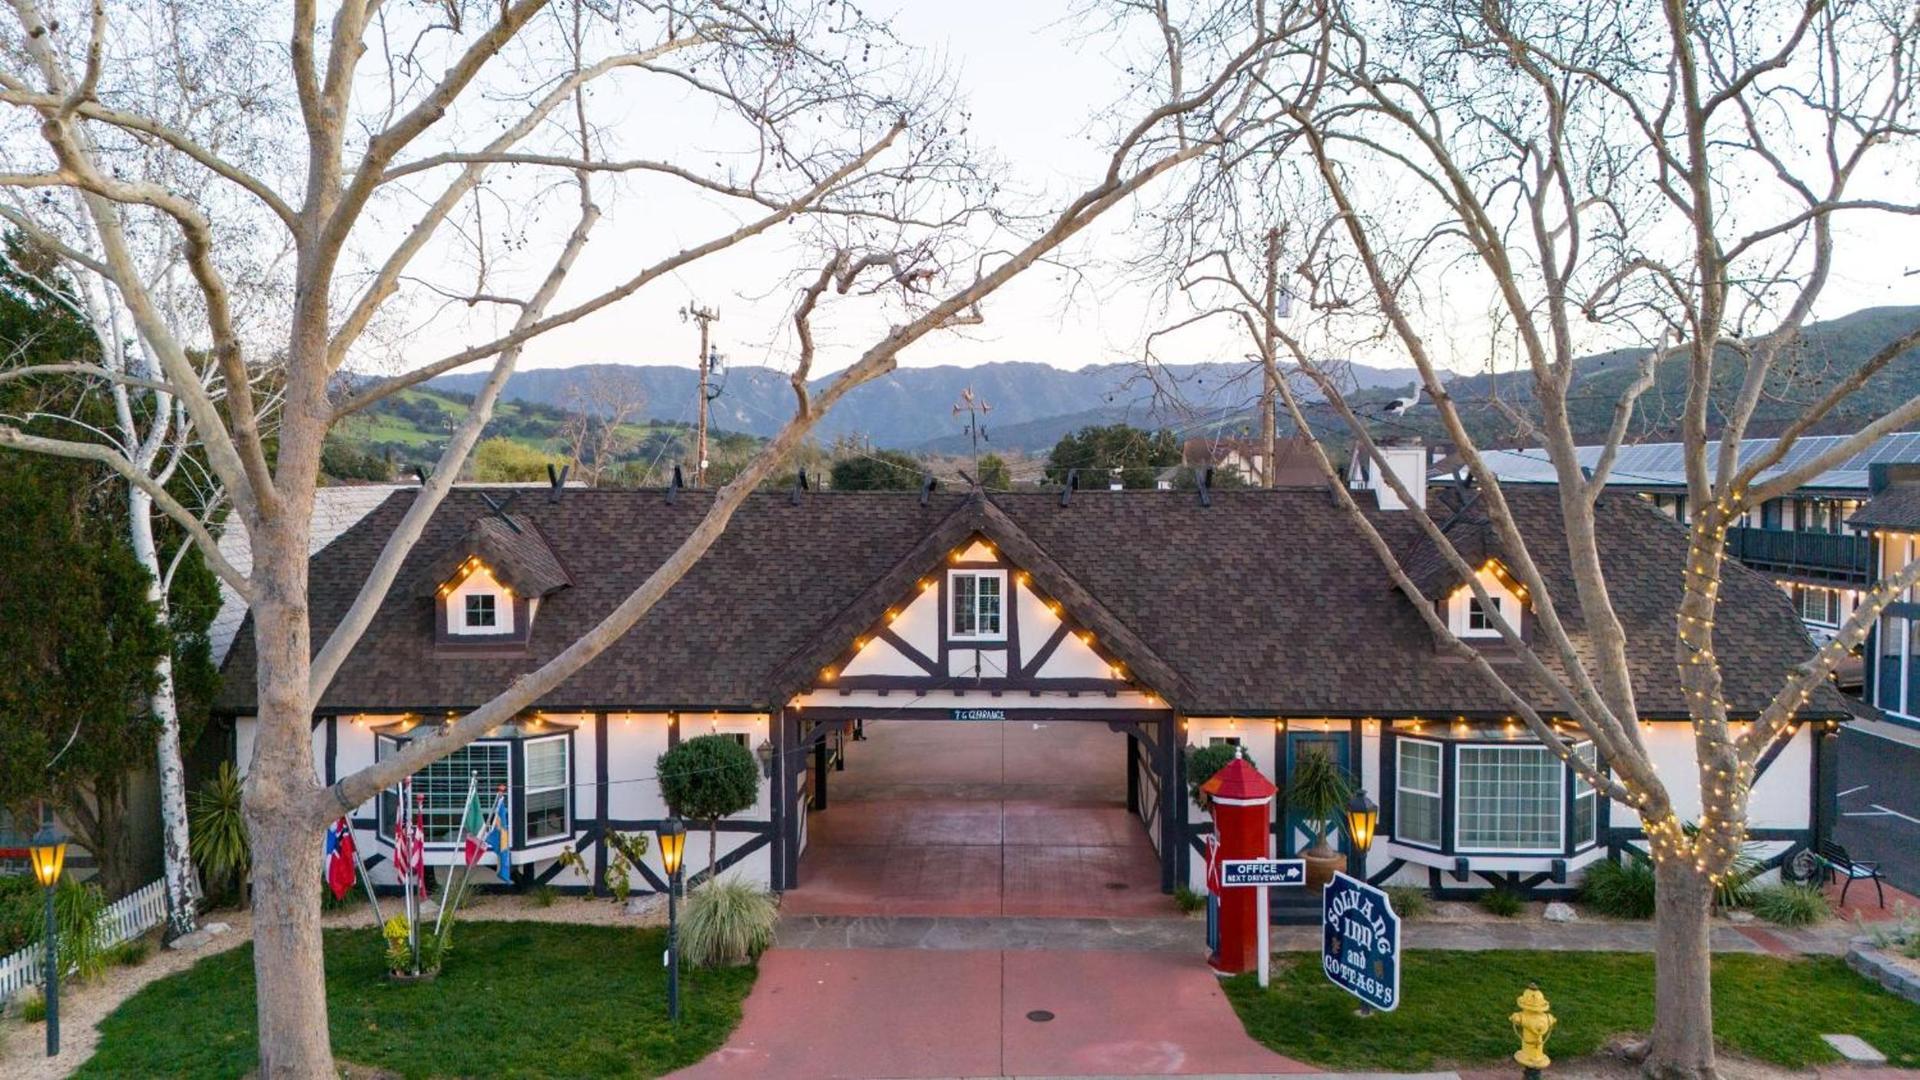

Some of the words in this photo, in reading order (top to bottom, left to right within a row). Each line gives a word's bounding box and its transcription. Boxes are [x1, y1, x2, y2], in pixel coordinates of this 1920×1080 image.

[1237, 864, 1277, 874] OFFICE
[1247, 874, 1285, 882] DRIVEWAY
[1328, 889, 1391, 955] SOLVANG
[1347, 949, 1366, 969] and
[1325, 954, 1392, 1005] COTTAGES
